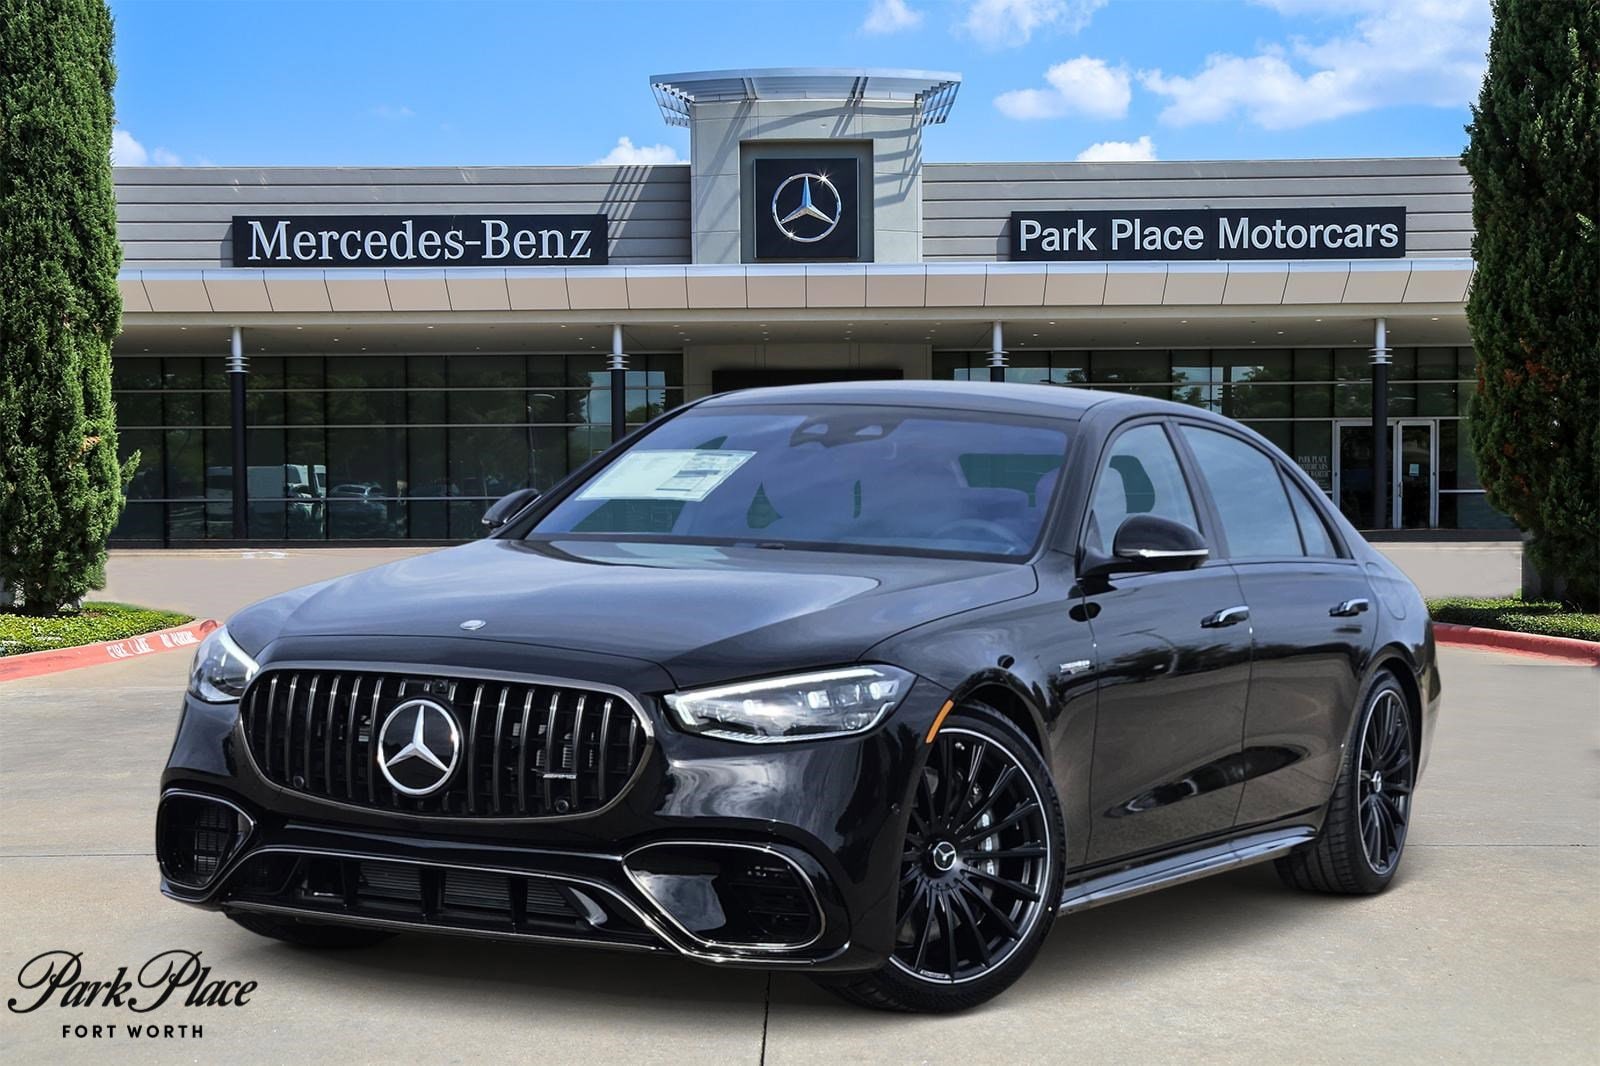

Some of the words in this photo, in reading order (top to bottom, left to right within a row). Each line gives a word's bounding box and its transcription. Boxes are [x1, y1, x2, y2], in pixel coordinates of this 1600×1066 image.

[248, 219, 592, 261] Mercedes-Benz
[1020, 219, 1097, 252] Park
[1112, 219, 1204, 251] Place
[1218, 217, 1399, 250] Motorcars
